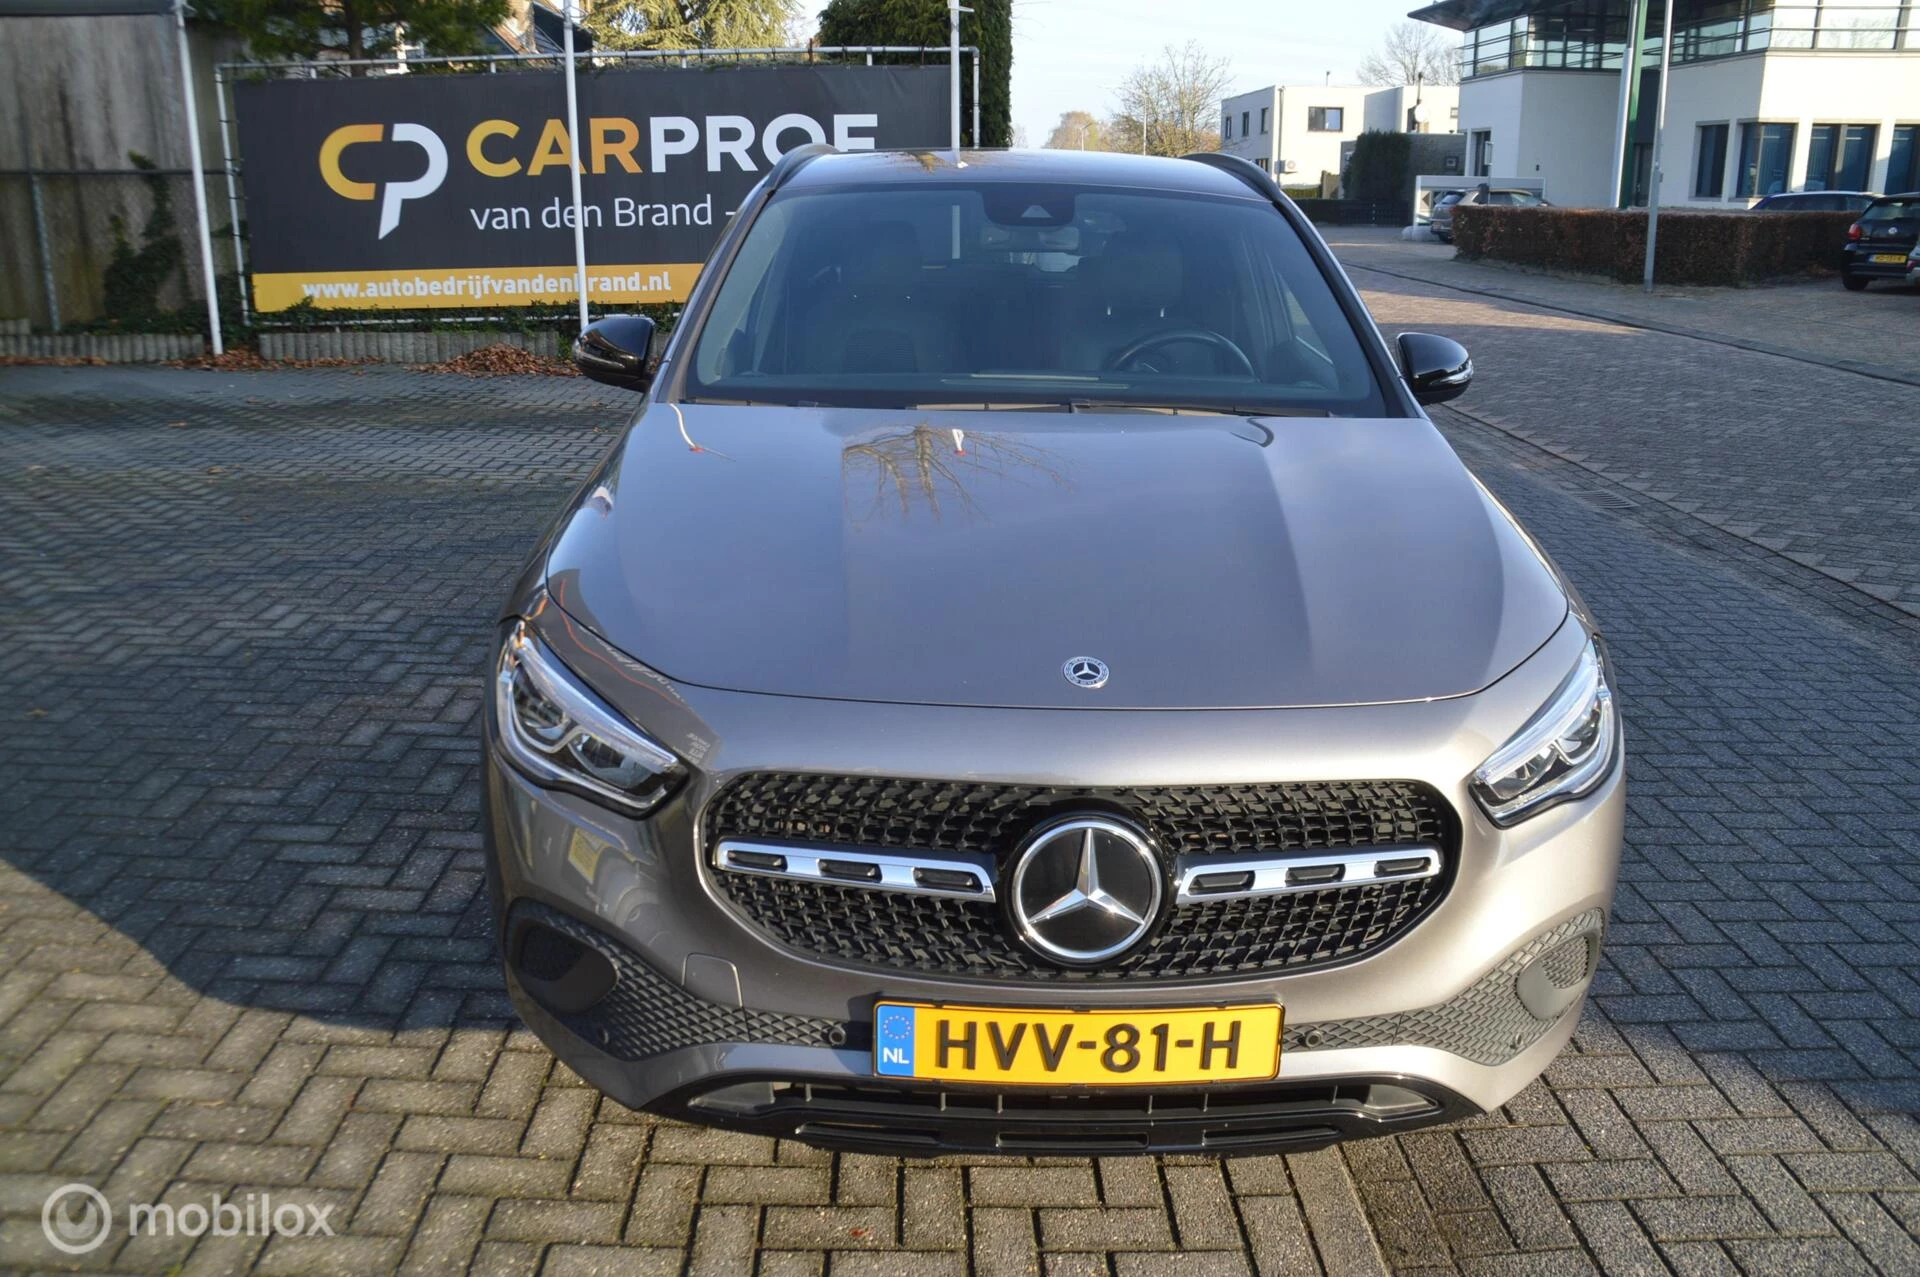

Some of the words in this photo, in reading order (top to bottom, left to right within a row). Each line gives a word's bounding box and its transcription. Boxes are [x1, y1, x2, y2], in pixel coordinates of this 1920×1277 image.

[470, 207, 531, 231] van
[541, 197, 602, 228] den
[614, 194, 713, 227] Brand
[882, 1047, 911, 1065] NL
[935, 1019, 1242, 1073] HVV-81-H
